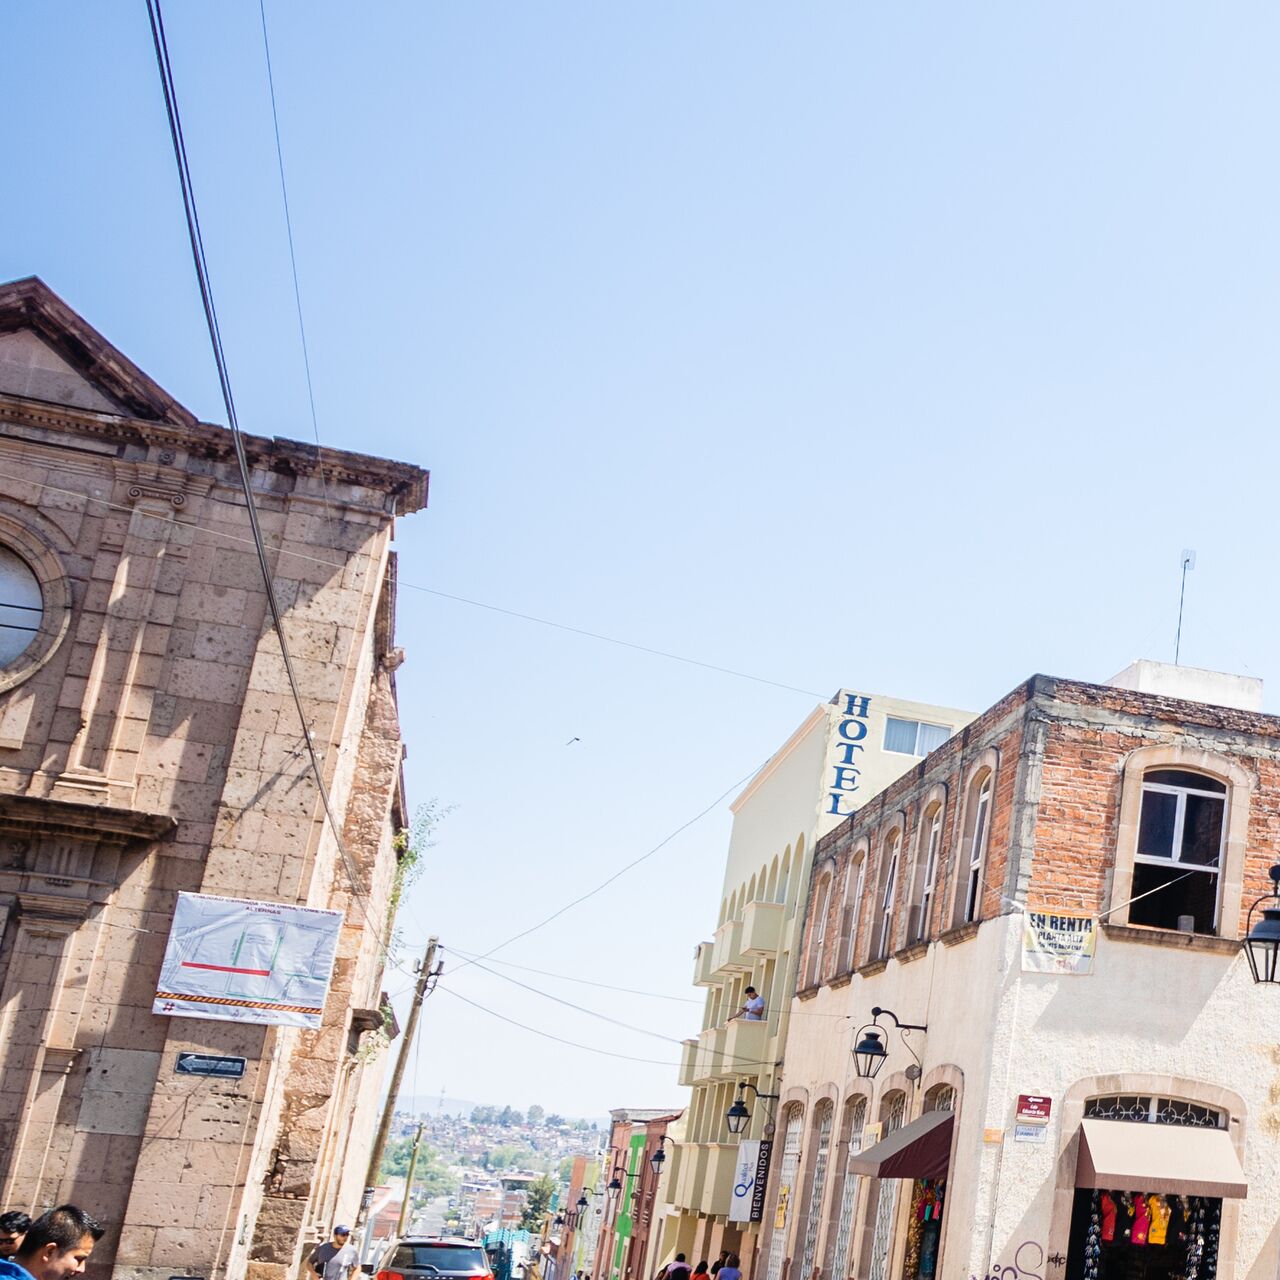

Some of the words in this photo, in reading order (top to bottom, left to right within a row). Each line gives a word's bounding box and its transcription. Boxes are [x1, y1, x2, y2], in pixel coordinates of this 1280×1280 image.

[826, 693, 872, 817] HOTEL
[1030, 913, 1046, 929] EN
[1050, 915, 1092, 933] RENTA
[751, 1143, 769, 1218] BIENVENIDOS
